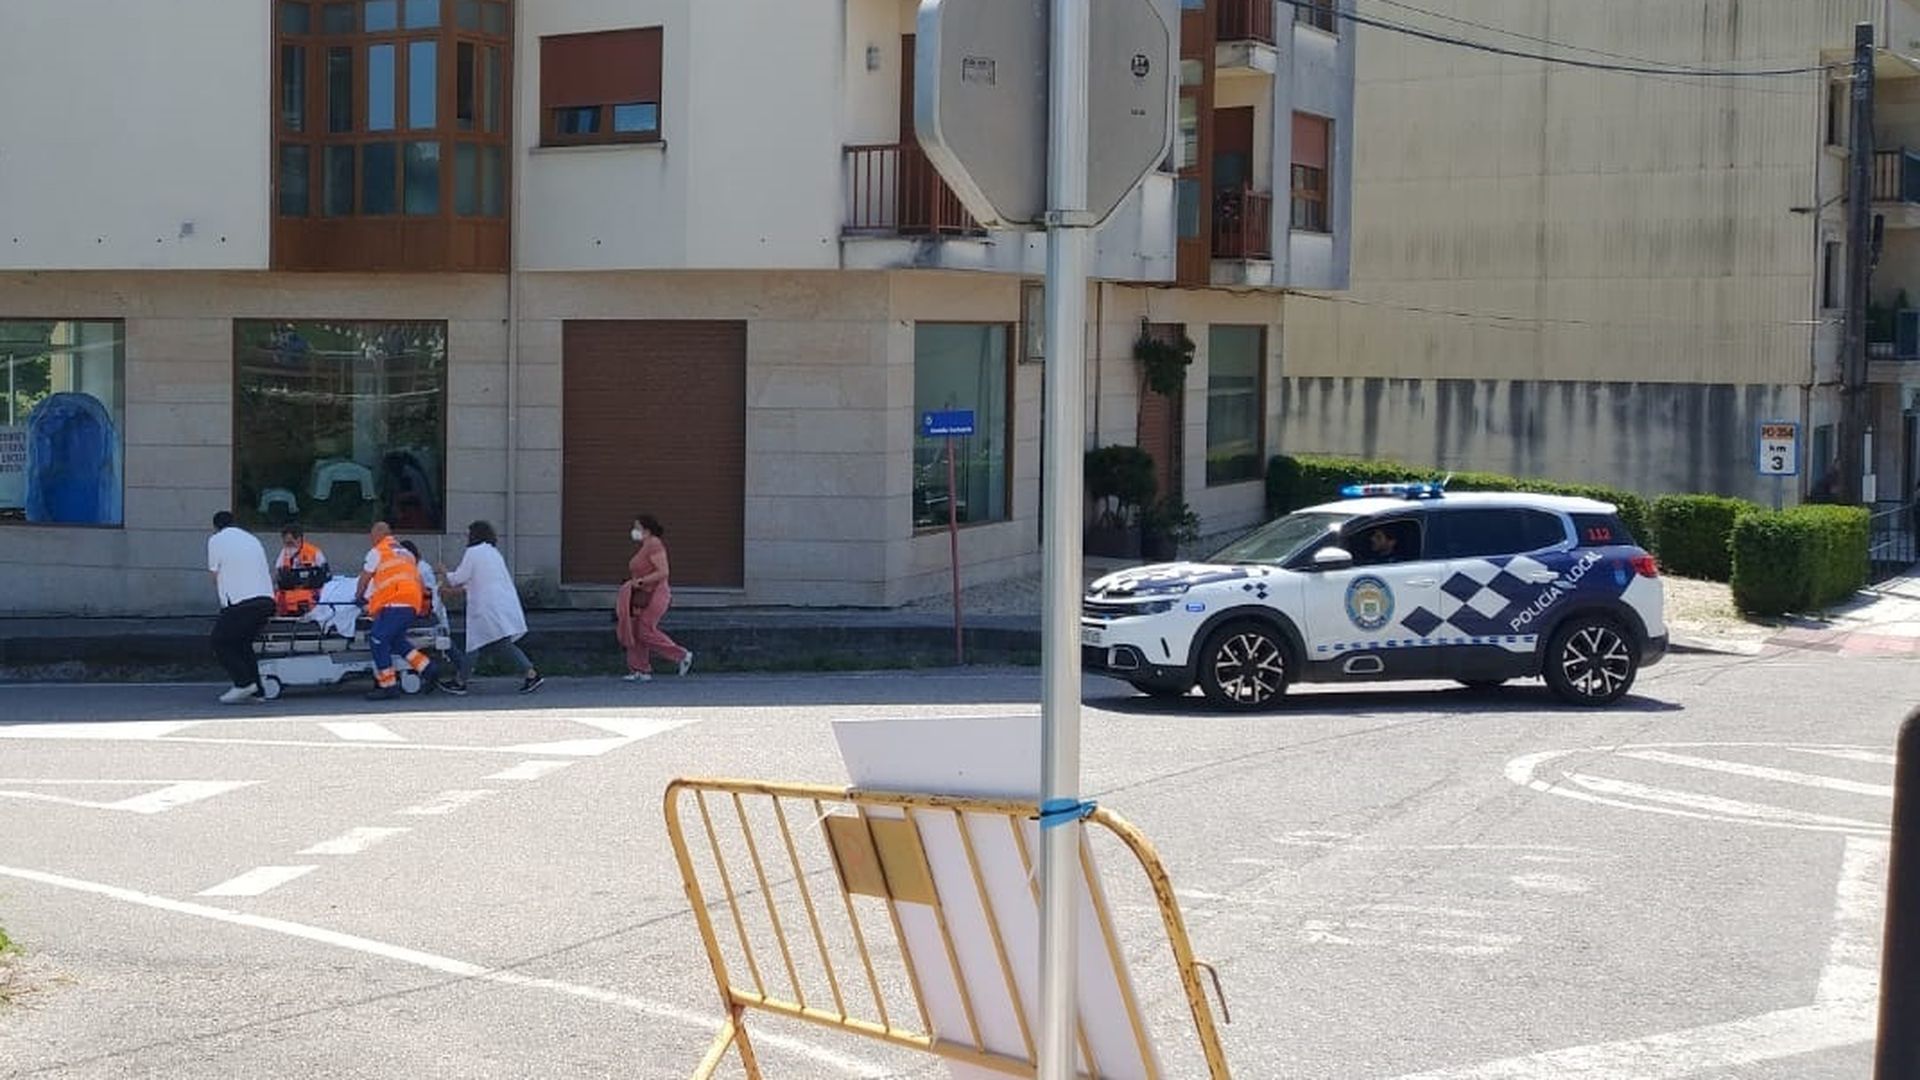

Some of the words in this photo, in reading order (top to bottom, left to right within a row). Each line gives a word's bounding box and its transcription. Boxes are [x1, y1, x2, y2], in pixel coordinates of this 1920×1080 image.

[1769, 444, 1786, 452] km
[1771, 456, 1783, 470] 3
[1587, 527, 1610, 540] 112
[1564, 551, 1603, 582] LOCAL
